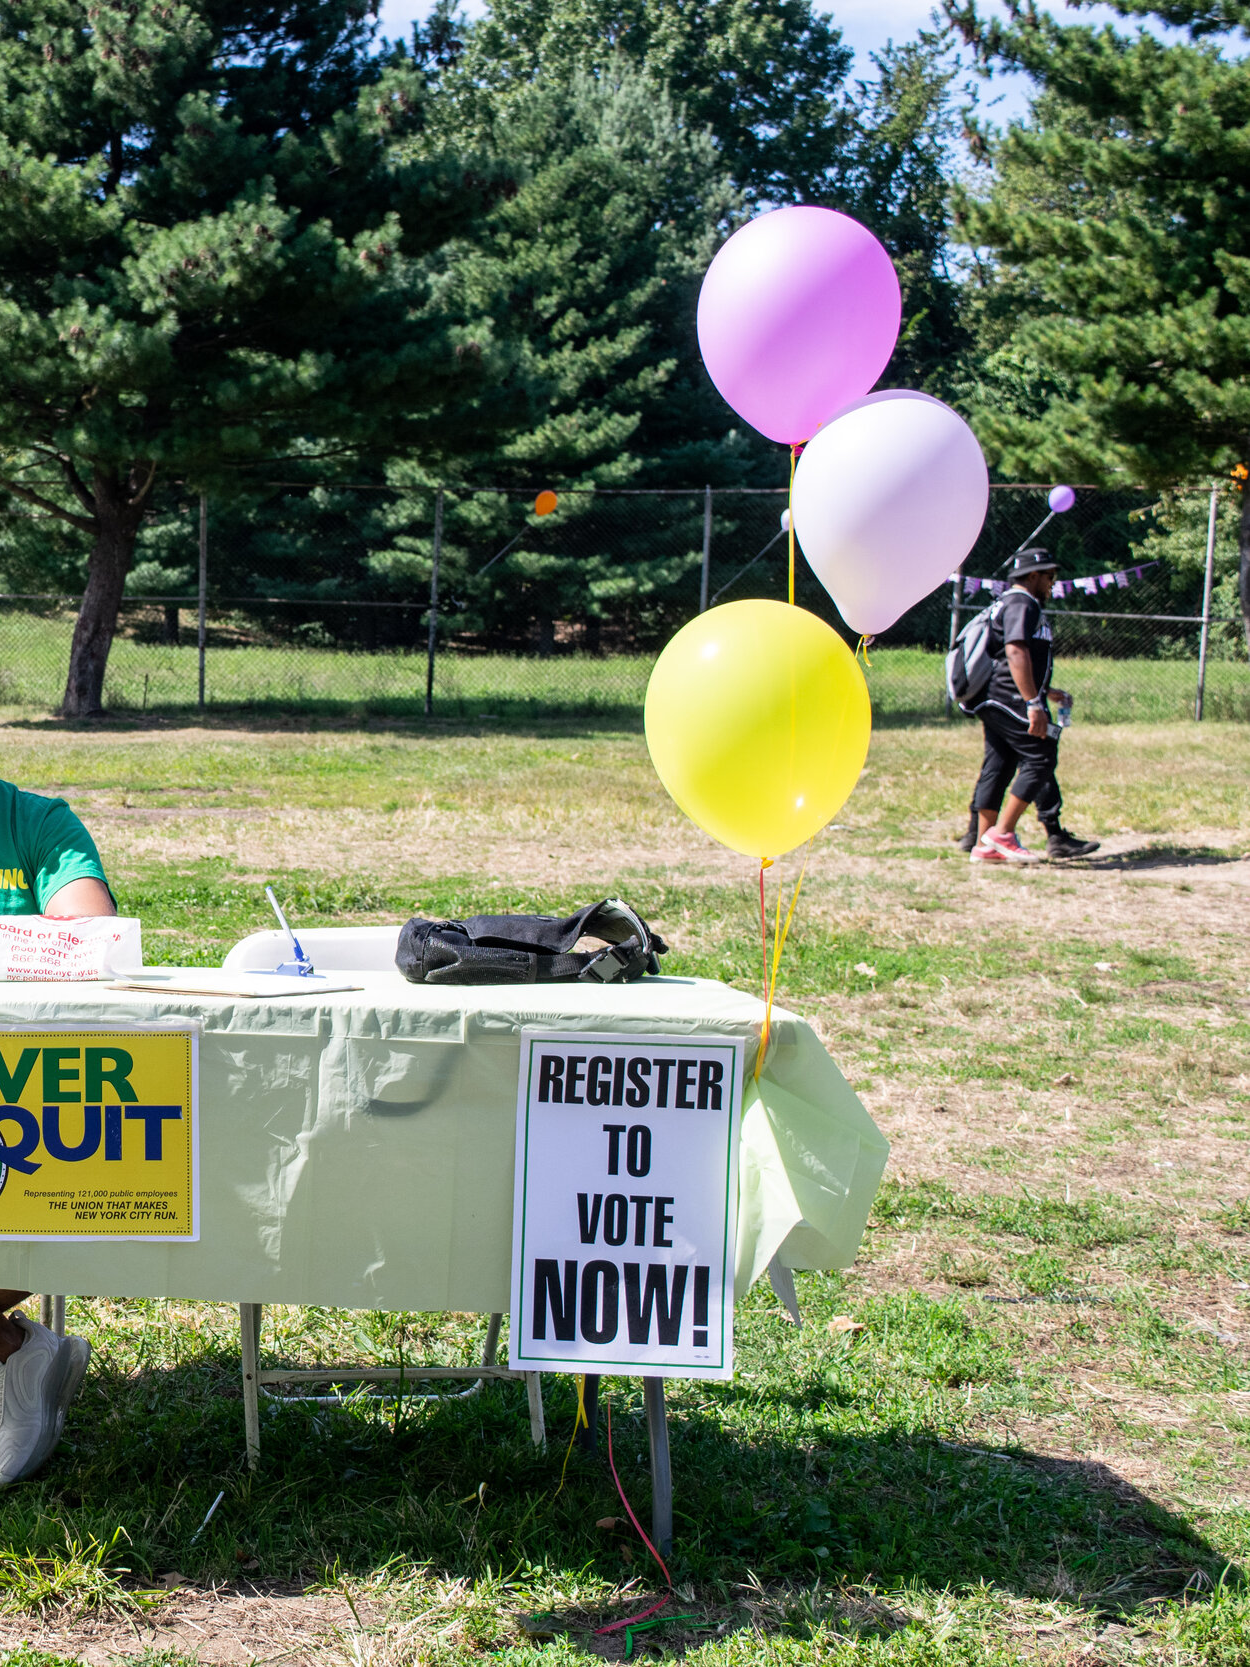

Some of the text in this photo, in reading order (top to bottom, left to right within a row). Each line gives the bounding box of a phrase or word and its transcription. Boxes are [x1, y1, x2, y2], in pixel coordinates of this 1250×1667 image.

[41, 946, 70, 959] VOTE
[538, 1054, 723, 1110] REGISTER
[602, 1124, 652, 1177] TO
[24, 1189, 178, 1198] Representing 121,000 public employees
[49, 1201, 168, 1209] THE UNION THAT MAKES
[75, 1211, 178, 1220] NEW YORK CITY RUN.
[577, 1192, 674, 1248] VOTE
[532, 1258, 710, 1347] NOW!
